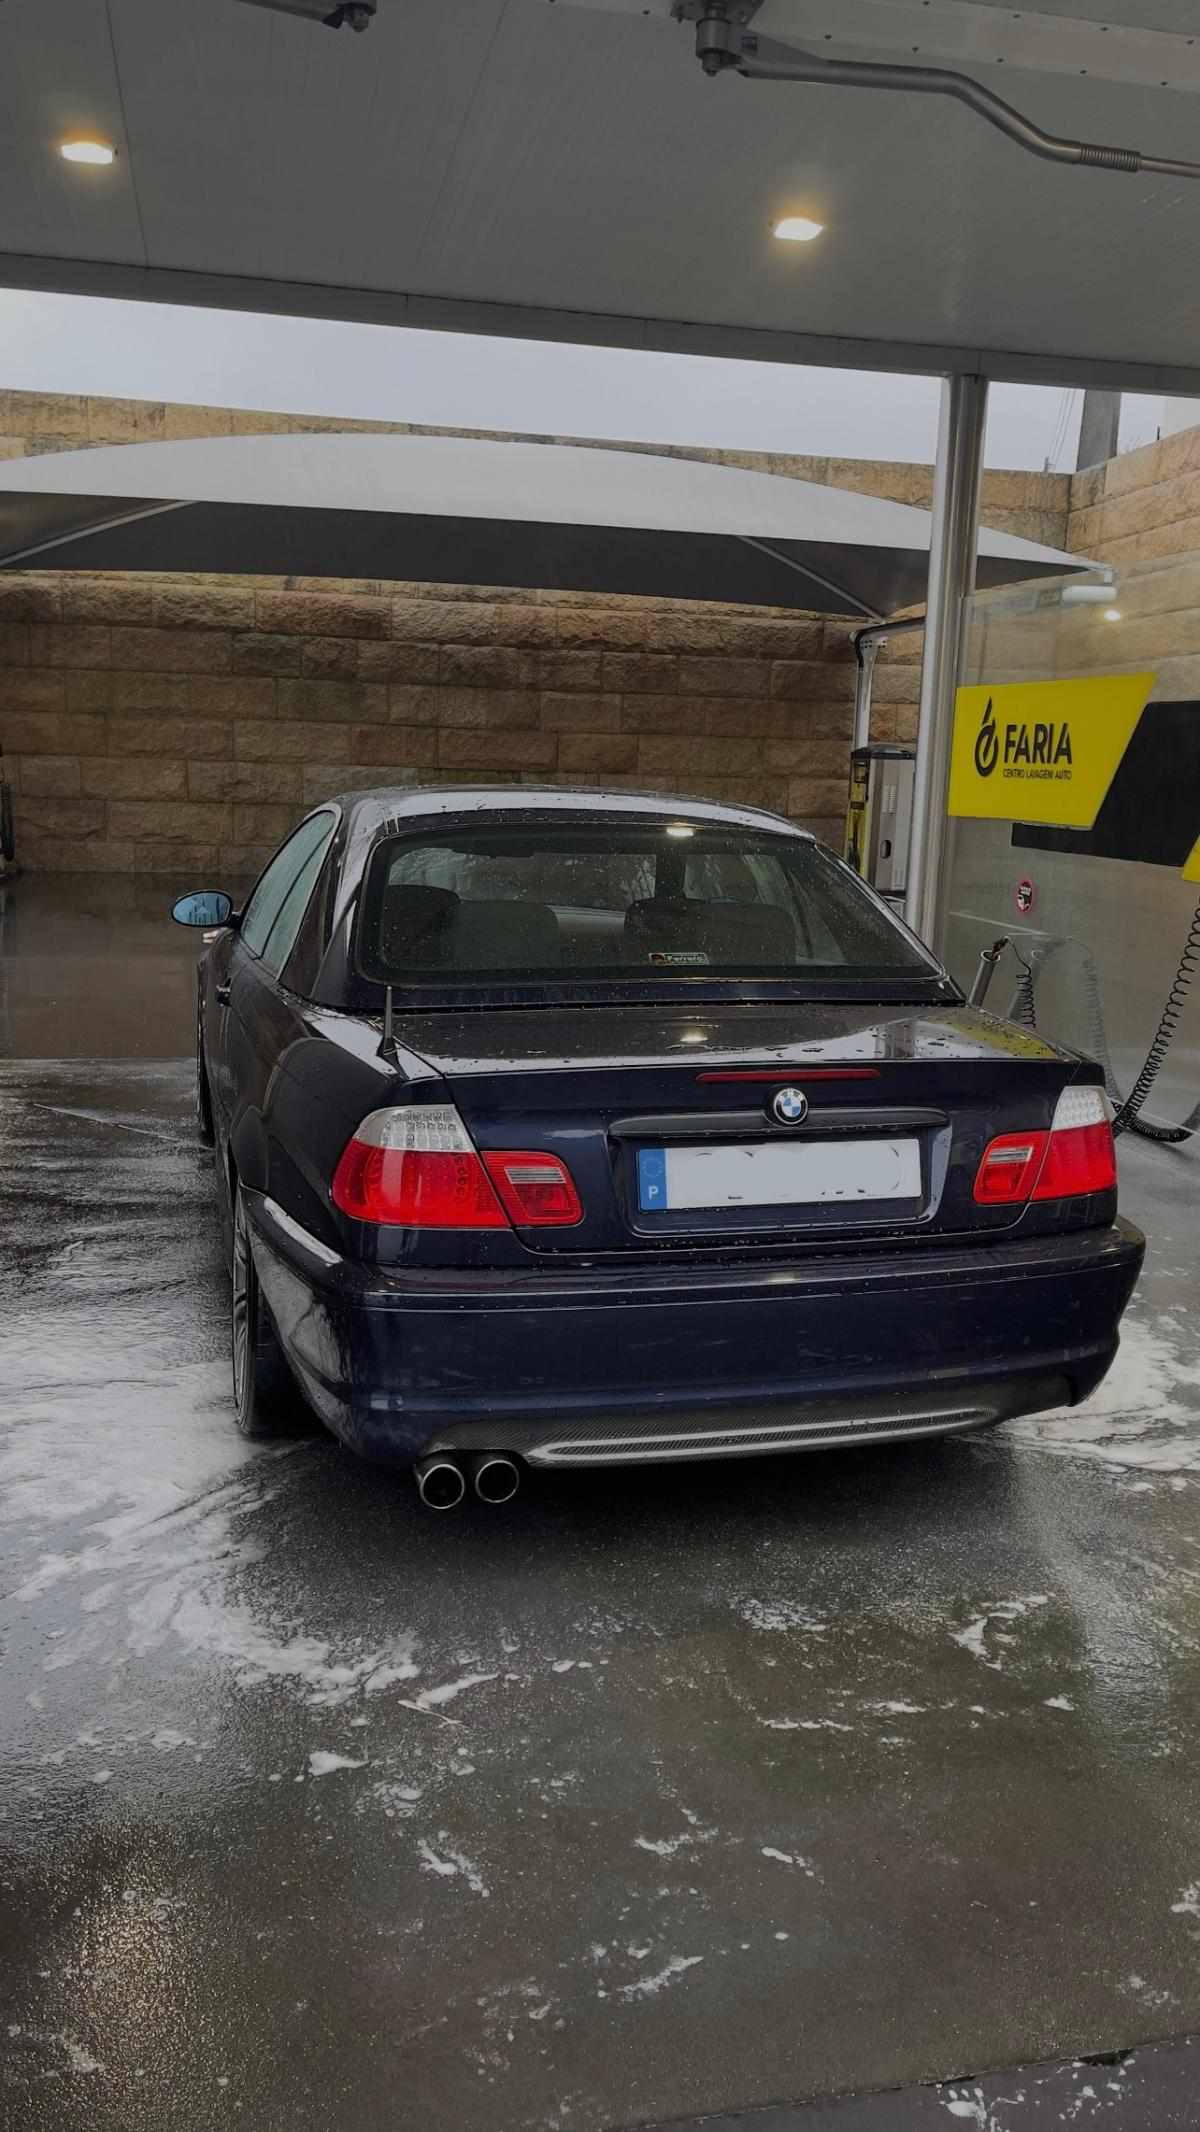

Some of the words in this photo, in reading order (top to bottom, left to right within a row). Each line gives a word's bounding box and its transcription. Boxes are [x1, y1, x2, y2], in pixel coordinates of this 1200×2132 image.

[1004, 723, 1072, 764] FARIA
[1003, 768, 1025, 778] CENTRO
[1055, 770, 1072, 780] AUTO
[648, 1185, 659, 1200] P
